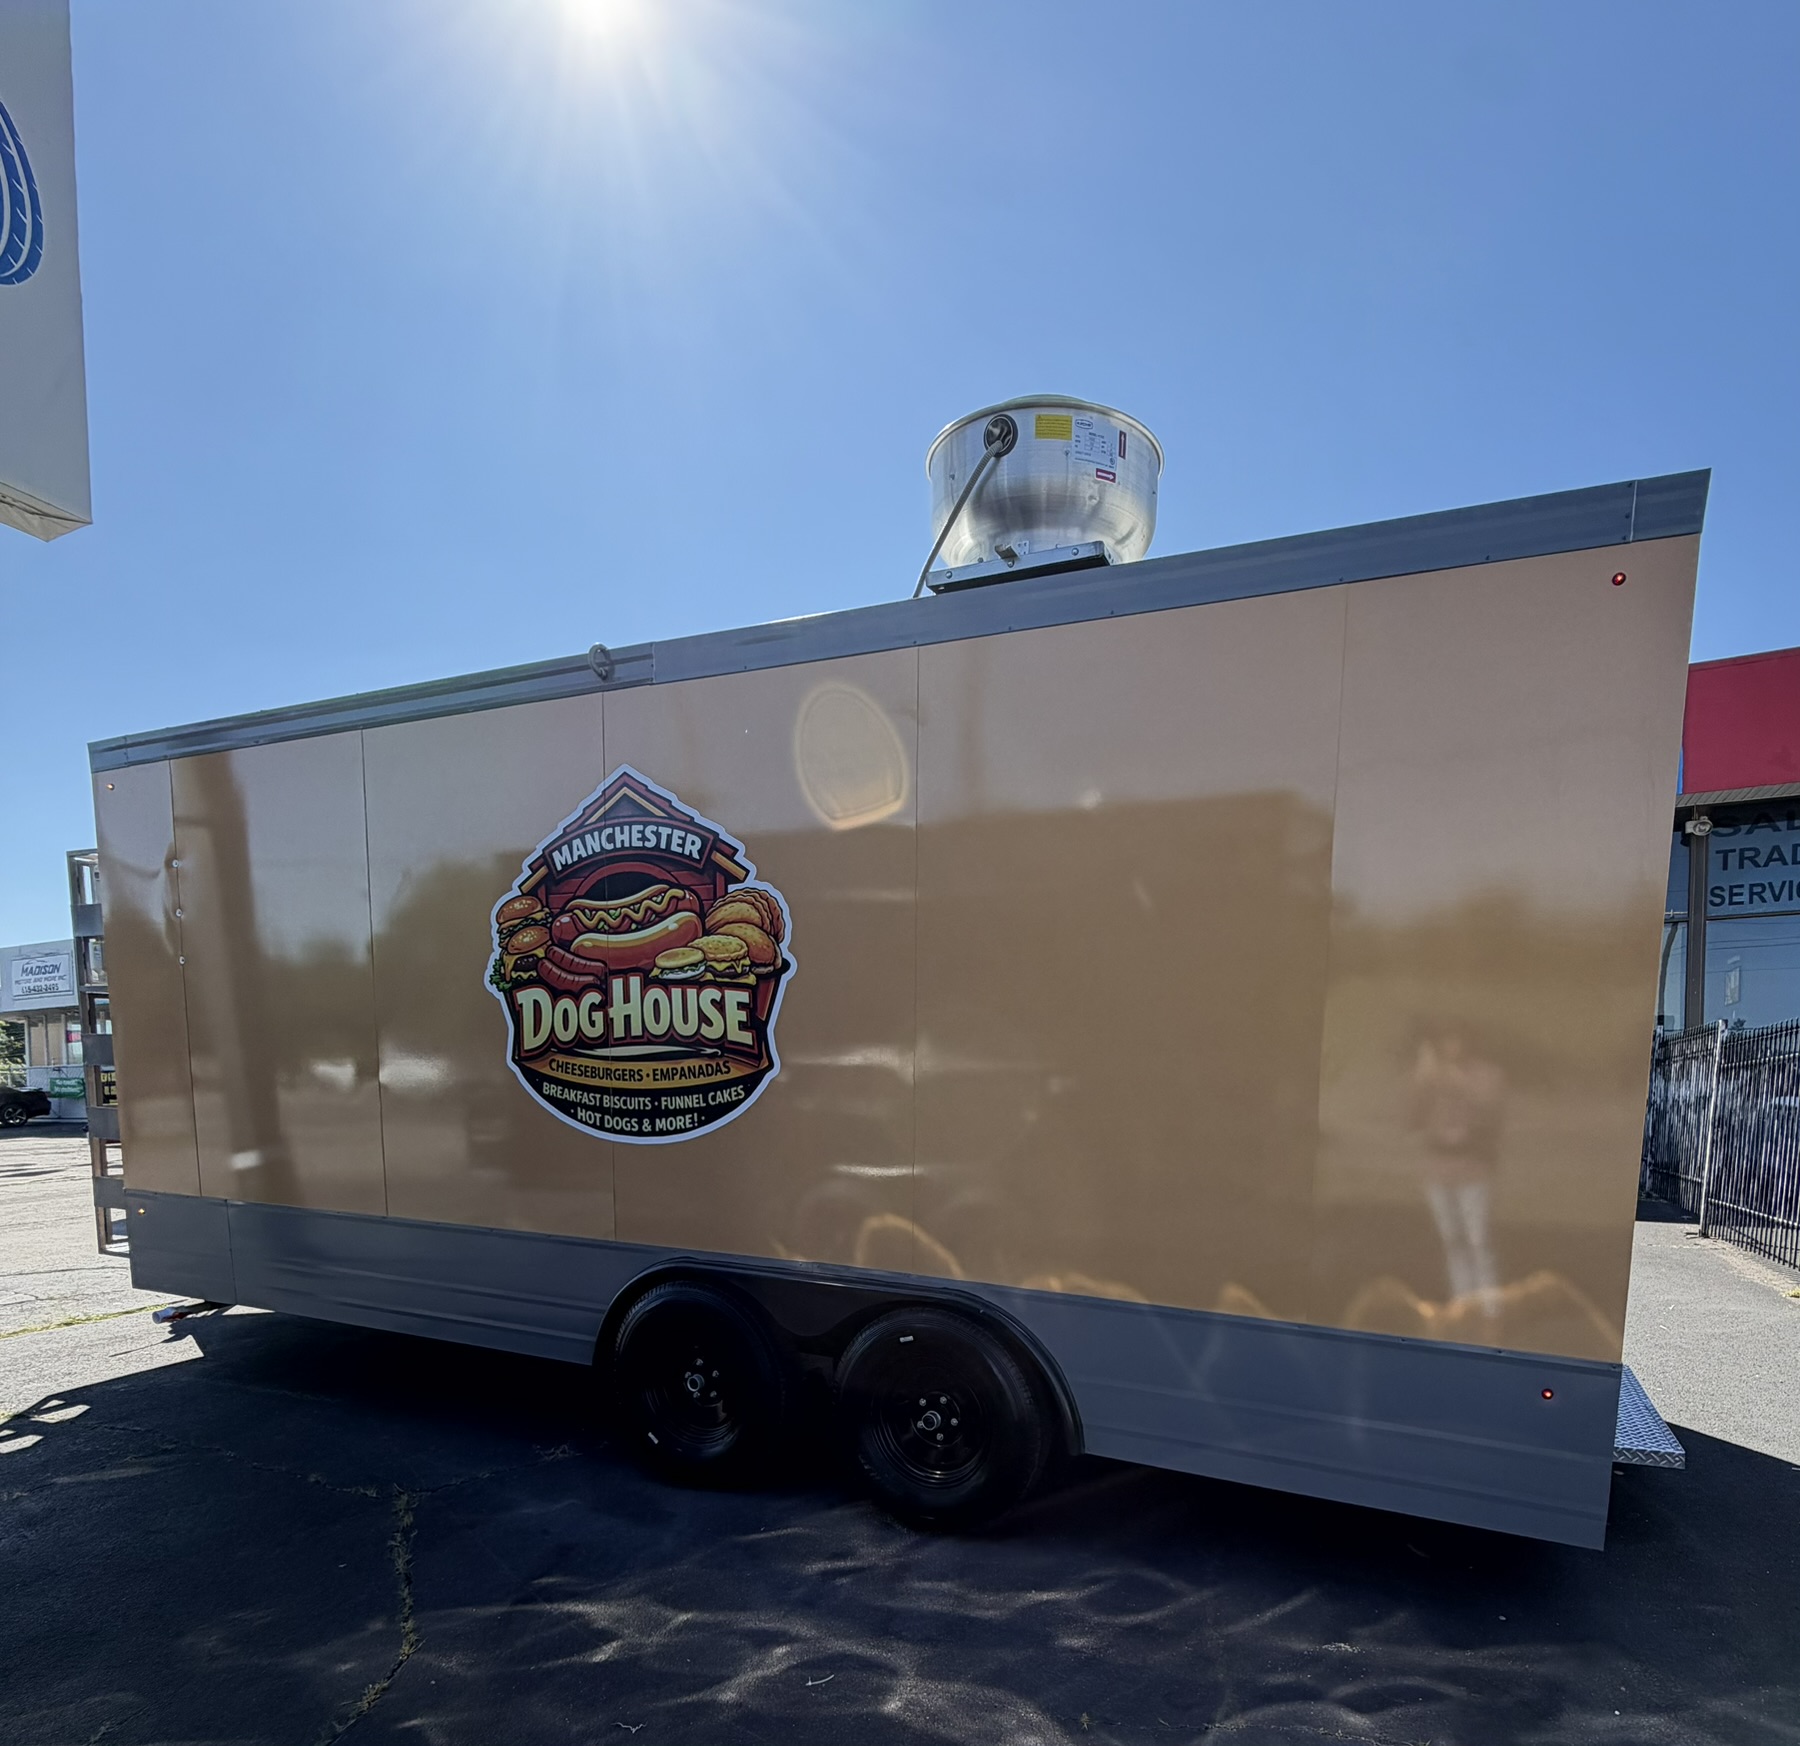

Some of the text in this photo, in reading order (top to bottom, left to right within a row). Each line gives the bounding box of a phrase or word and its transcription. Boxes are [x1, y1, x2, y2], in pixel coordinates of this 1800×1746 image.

[552, 824, 702, 872] MANCHESTER
[1709, 880, 1800, 907] SERVI
[21, 961, 62, 977] MADISON
[549, 1058, 731, 1082] CHEESEBURGERS EMPANADAS
[543, 1082, 745, 1110] BREAKFAST BISCUITS FUNNEL CAKES
[577, 1106, 698, 1132] HOT DOGS & MORE!
